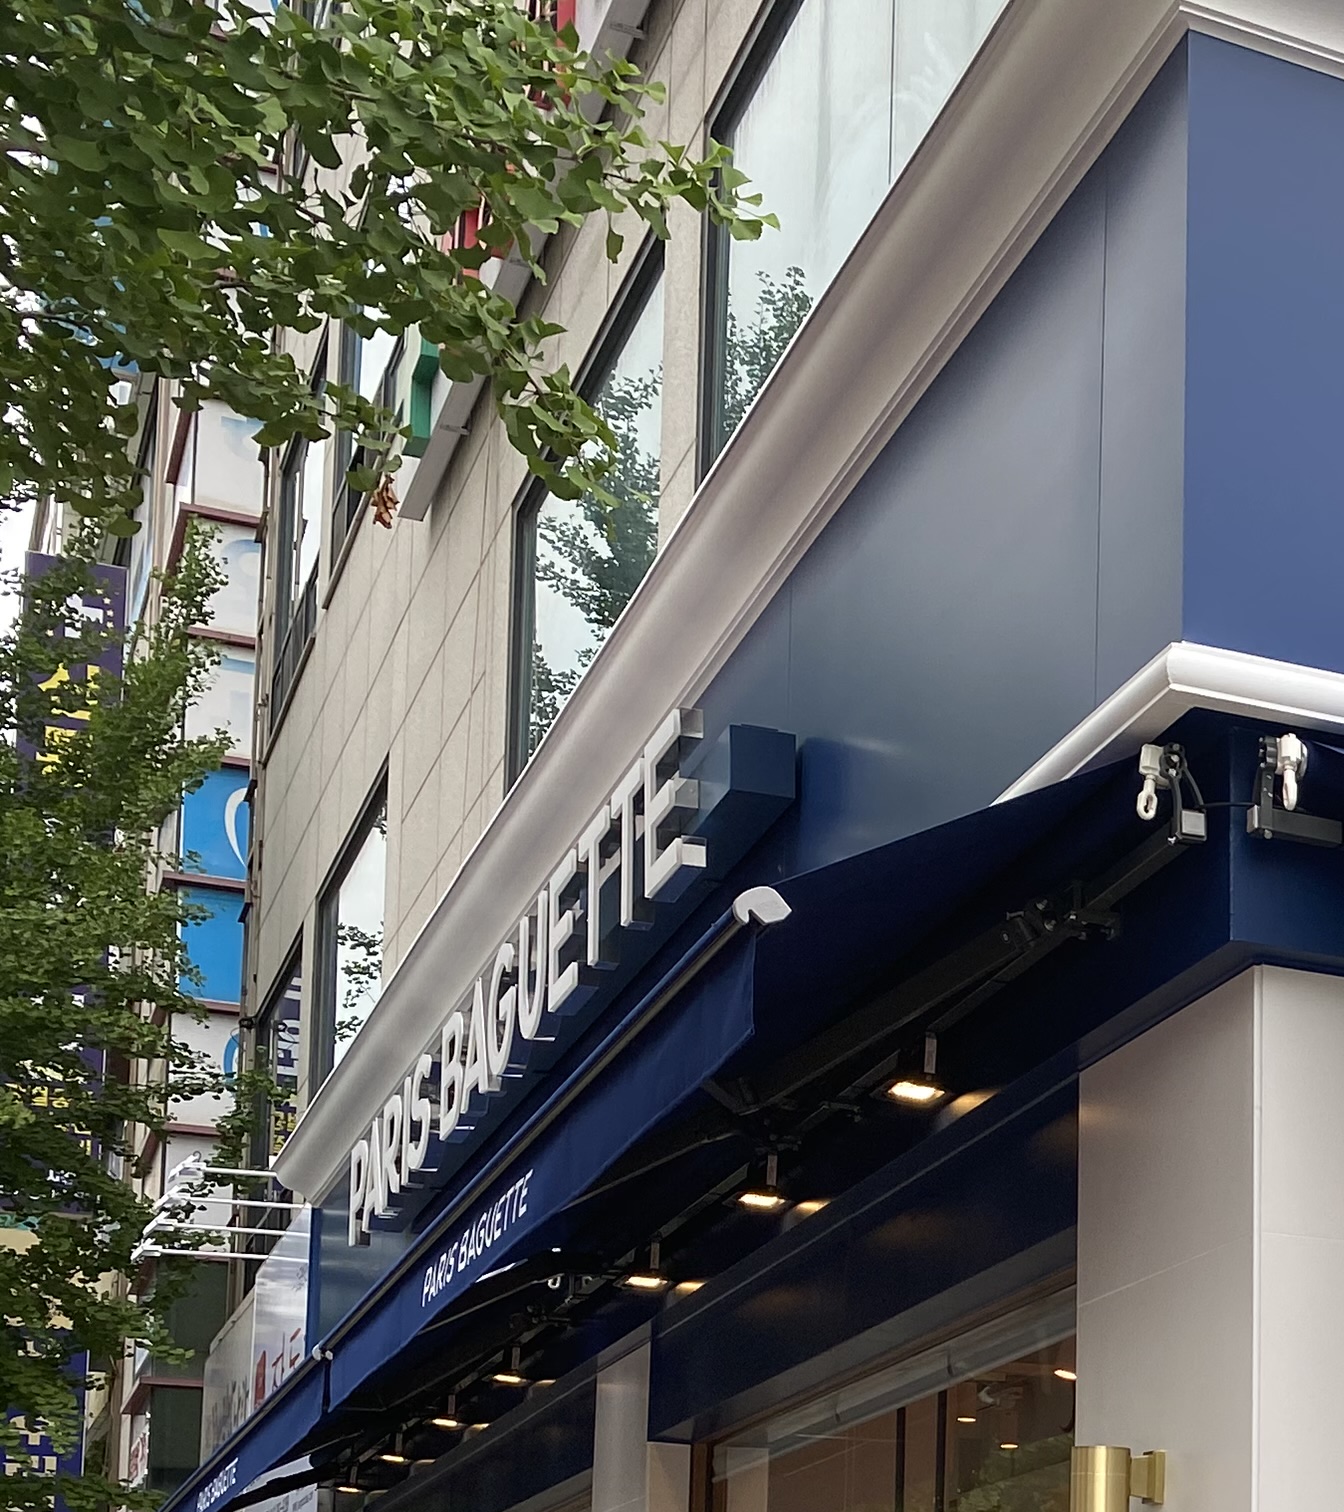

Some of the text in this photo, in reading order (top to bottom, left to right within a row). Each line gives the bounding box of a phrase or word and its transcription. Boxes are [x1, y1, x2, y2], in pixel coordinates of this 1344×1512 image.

[346, 706, 708, 1248] PARIS BAGUETTE
[421, 1169, 536, 1308] PARIS BAGUETTE
